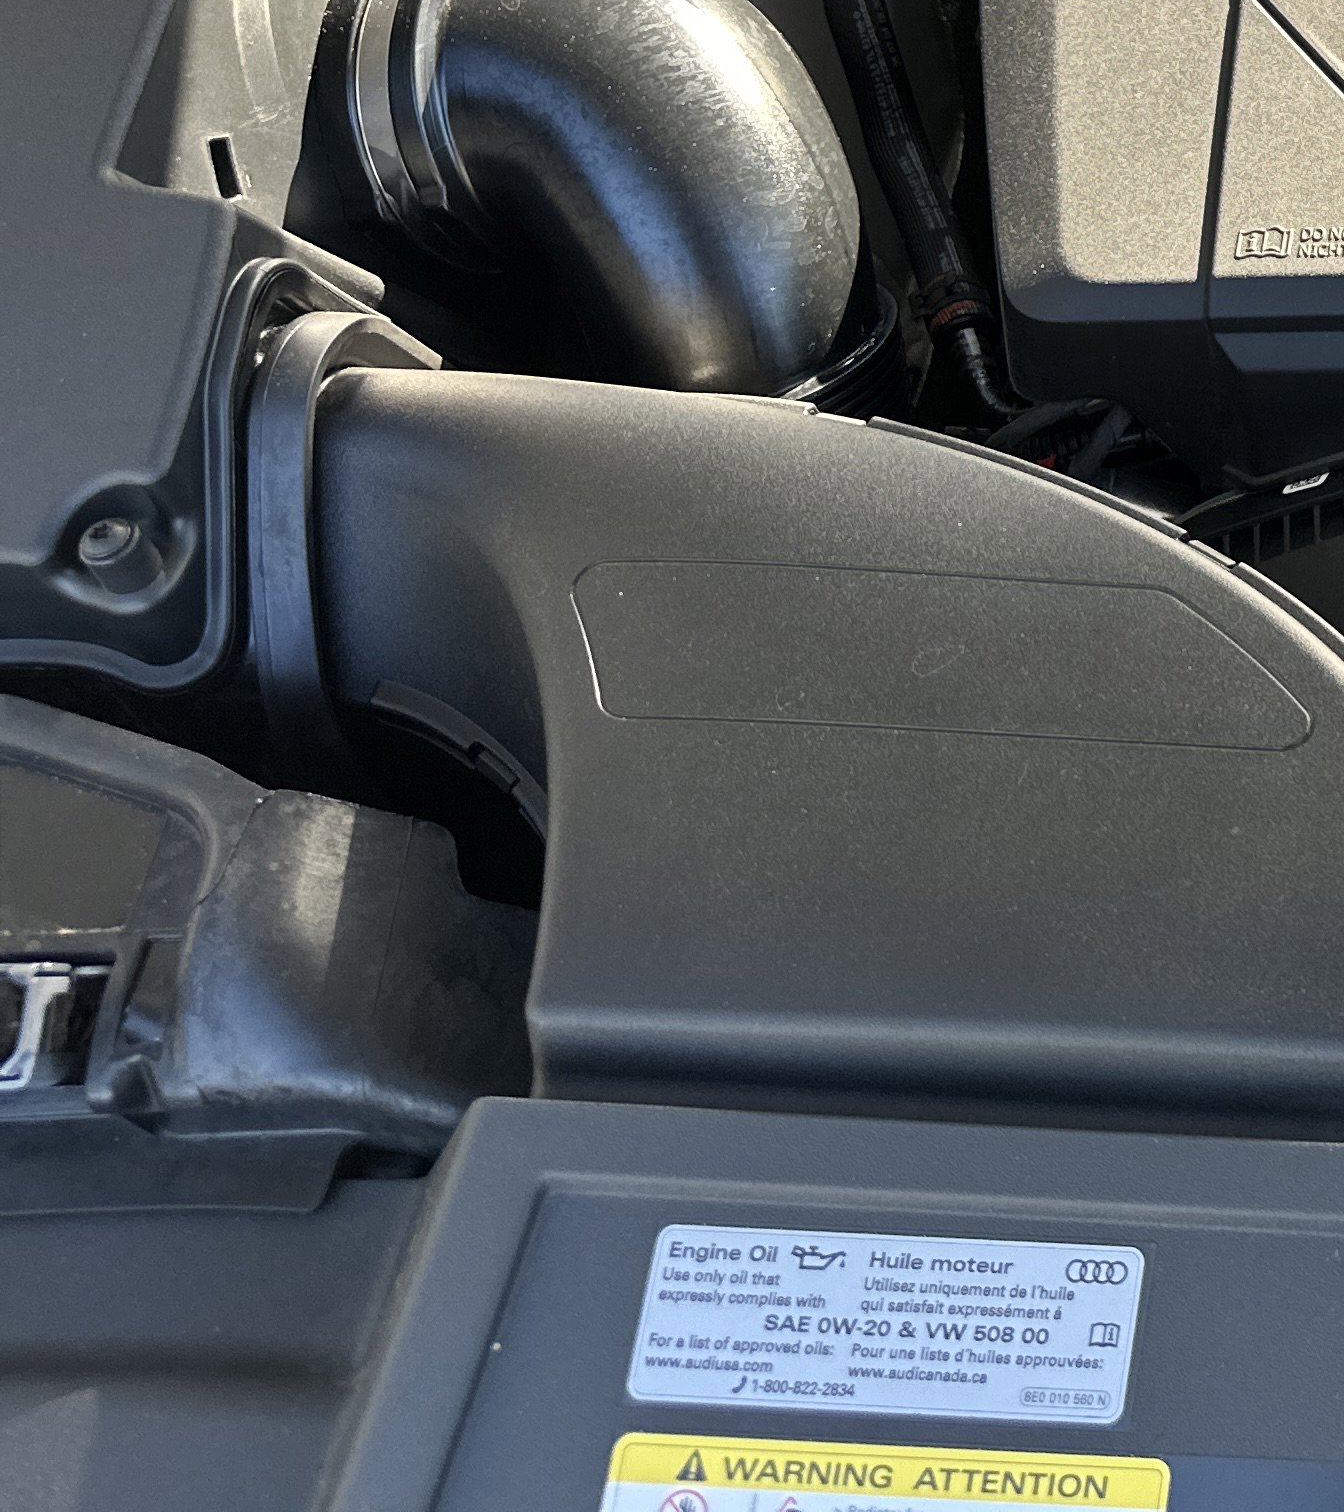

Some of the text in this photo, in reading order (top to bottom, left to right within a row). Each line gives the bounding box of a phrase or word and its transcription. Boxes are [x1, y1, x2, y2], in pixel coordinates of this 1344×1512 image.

[1299, 226, 1324, 243] DO
[669, 1241, 779, 1263] Engine Oil
[868, 1250, 1014, 1275] Huile moteur
[662, 1267, 781, 1286] Use only oil that
[863, 1276, 916, 1293] Utilisez
[919, 1280, 1005, 1299] uniquement
[1009, 1284, 1028, 1300] de
[658, 1290, 826, 1309] expressly complies with
[861, 1298, 885, 1313] qui
[887, 1299, 944, 1316] satisfait
[949, 1302, 1050, 1321] expressément
[763, 1314, 1050, 1345] SAE 0W-20 & VW 508 00
[648, 1333, 835, 1356] For a list of approved oils:
[645, 1354, 774, 1373] www.audiusa.com
[851, 1343, 885, 1360] Pour
[889, 1348, 916, 1361] une
[920, 1345, 951, 1362] liste
[1015, 1351, 1105, 1371] approuvées:
[847, 1365, 988, 1385] www.audicanada.ca
[751, 1379, 856, 1396] 1-800-822-2834
[1097, 1394, 1107, 1406] N
[722, 1455, 1109, 1500] WARNING ATTENTION
